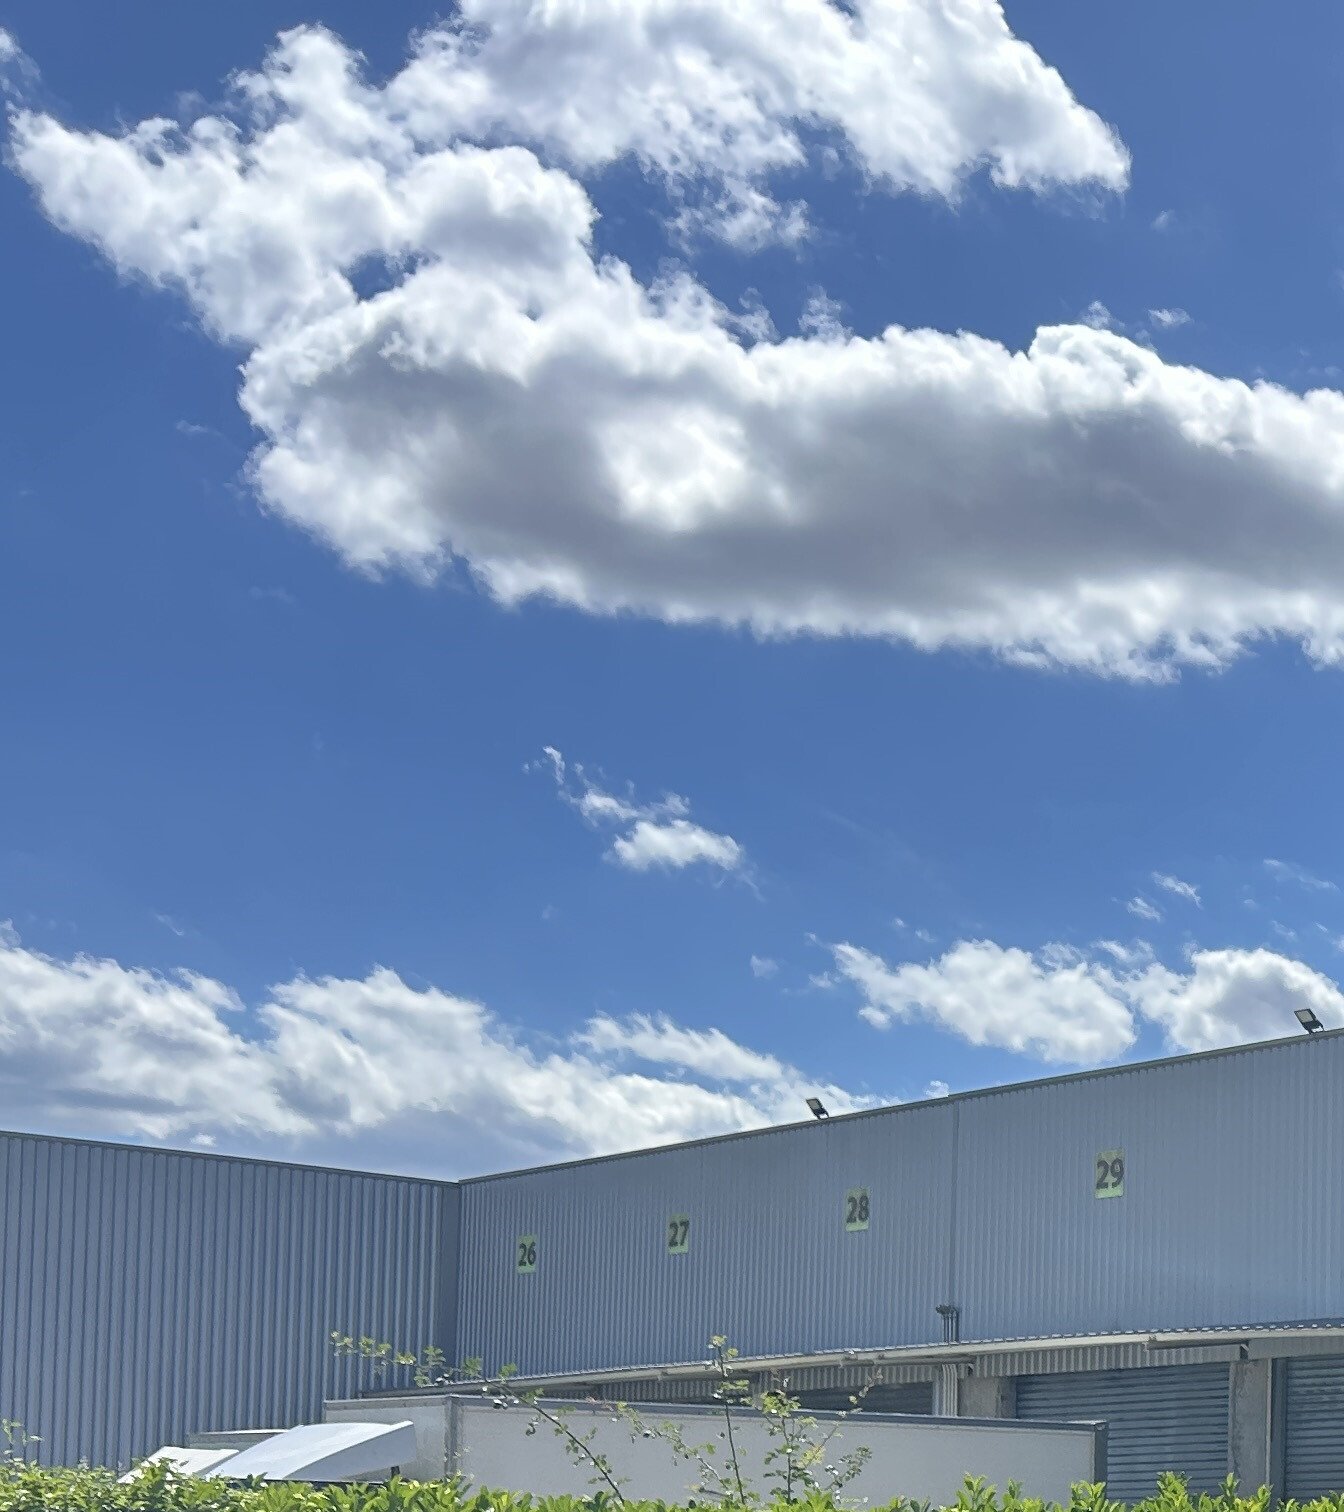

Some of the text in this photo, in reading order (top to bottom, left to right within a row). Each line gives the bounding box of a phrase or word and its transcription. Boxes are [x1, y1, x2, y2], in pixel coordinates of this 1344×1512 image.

[1095, 1157, 1125, 1190] 29
[845, 1195, 870, 1224] 28
[668, 1220, 690, 1248] 27
[517, 1241, 537, 1267] 26
